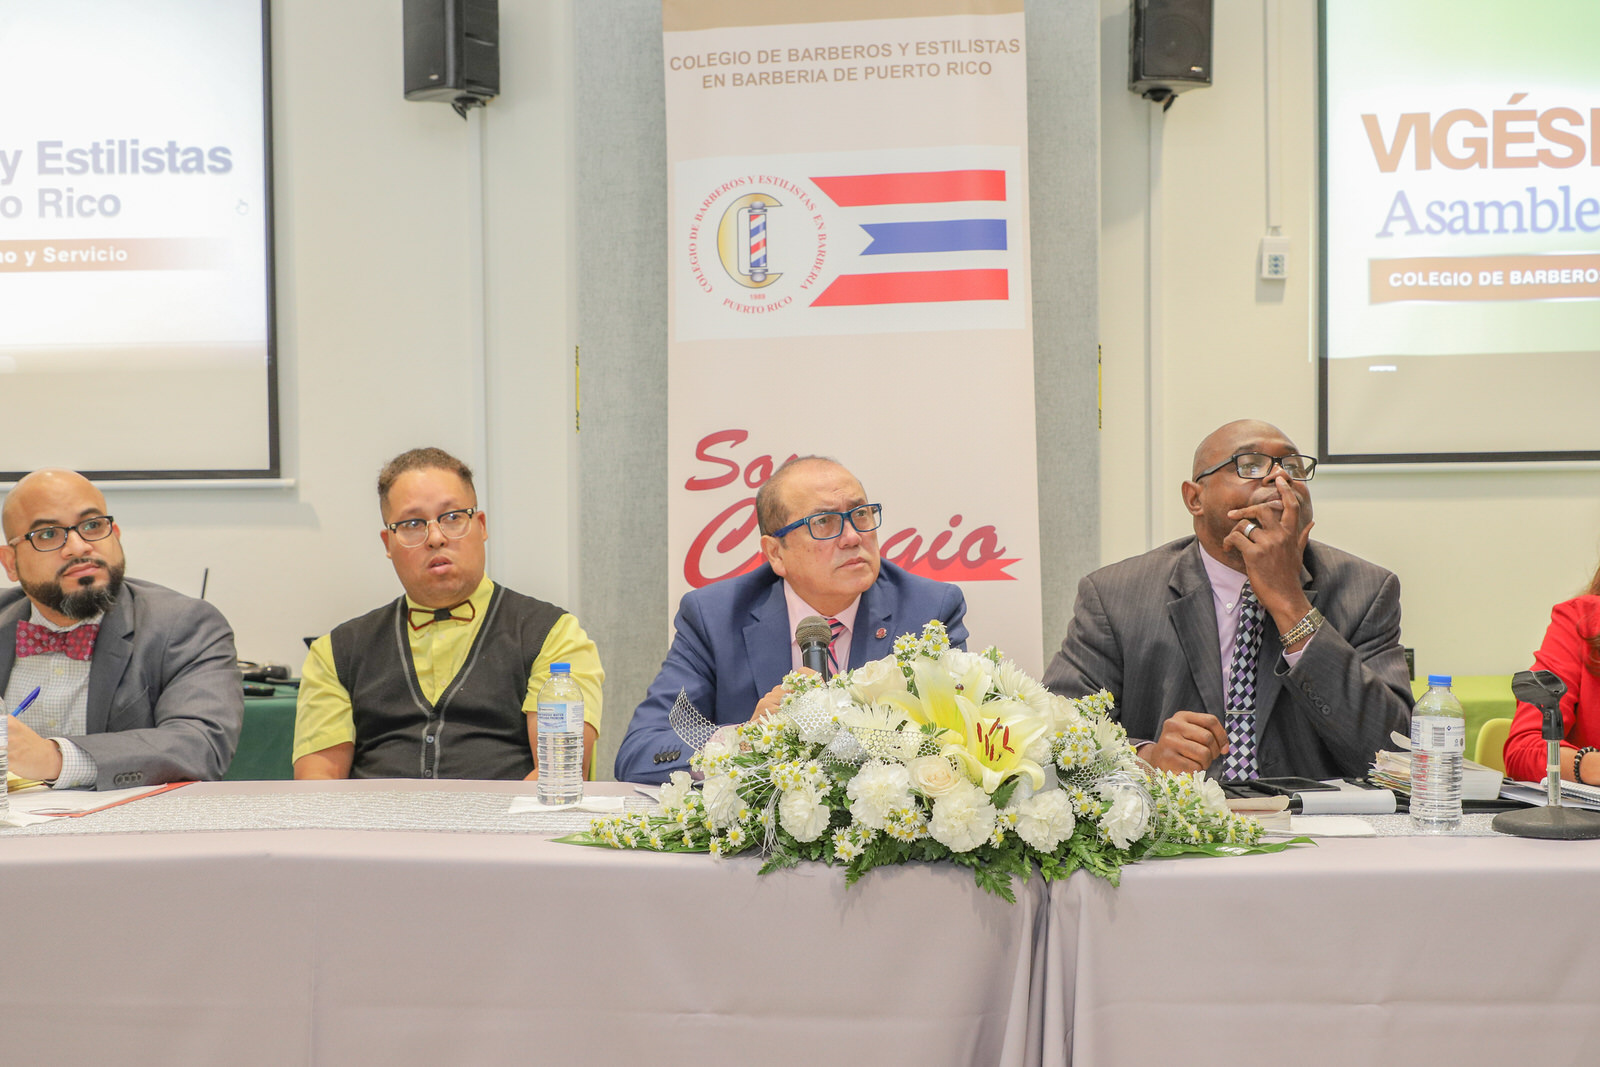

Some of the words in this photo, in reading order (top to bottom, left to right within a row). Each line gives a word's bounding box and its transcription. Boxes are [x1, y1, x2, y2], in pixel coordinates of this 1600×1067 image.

[670, 51, 751, 71] COLEGIO
[757, 48, 782, 64] DE
[788, 43, 893, 63] BARBEROS
[898, 42, 911, 57] Y
[915, 38, 1021, 56] ESTILISTAS
[702, 74, 726, 89] EN
[732, 69, 829, 87] BARBERIA
[833, 67, 858, 82] DE
[864, 62, 941, 80] PUERTO
[946, 61, 993, 77] RICO
[37, 139, 233, 176] Estilistas
[747, 175, 756, 184] Y
[758, 174, 817, 212] ESTILISTAS
[38, 186, 122, 219] Rico
[694, 175, 745, 222] BARBEROS
[1375, 185, 1600, 238] Asamble
[689, 224, 700, 240] DE
[813, 214, 826, 231] EN
[24, 250, 36, 268] y
[43, 245, 128, 263] Servicio
[688, 243, 713, 294] COLEGIO
[800, 233, 827, 290] BARBERIA
[1389, 270, 1473, 287] COLEGIO
[1478, 270, 1504, 286] DE
[1509, 268, 1600, 286] BARBERO
[722, 297, 765, 314] PUERTO
[767, 295, 793, 313] RICO
[684, 429, 799, 491] So
